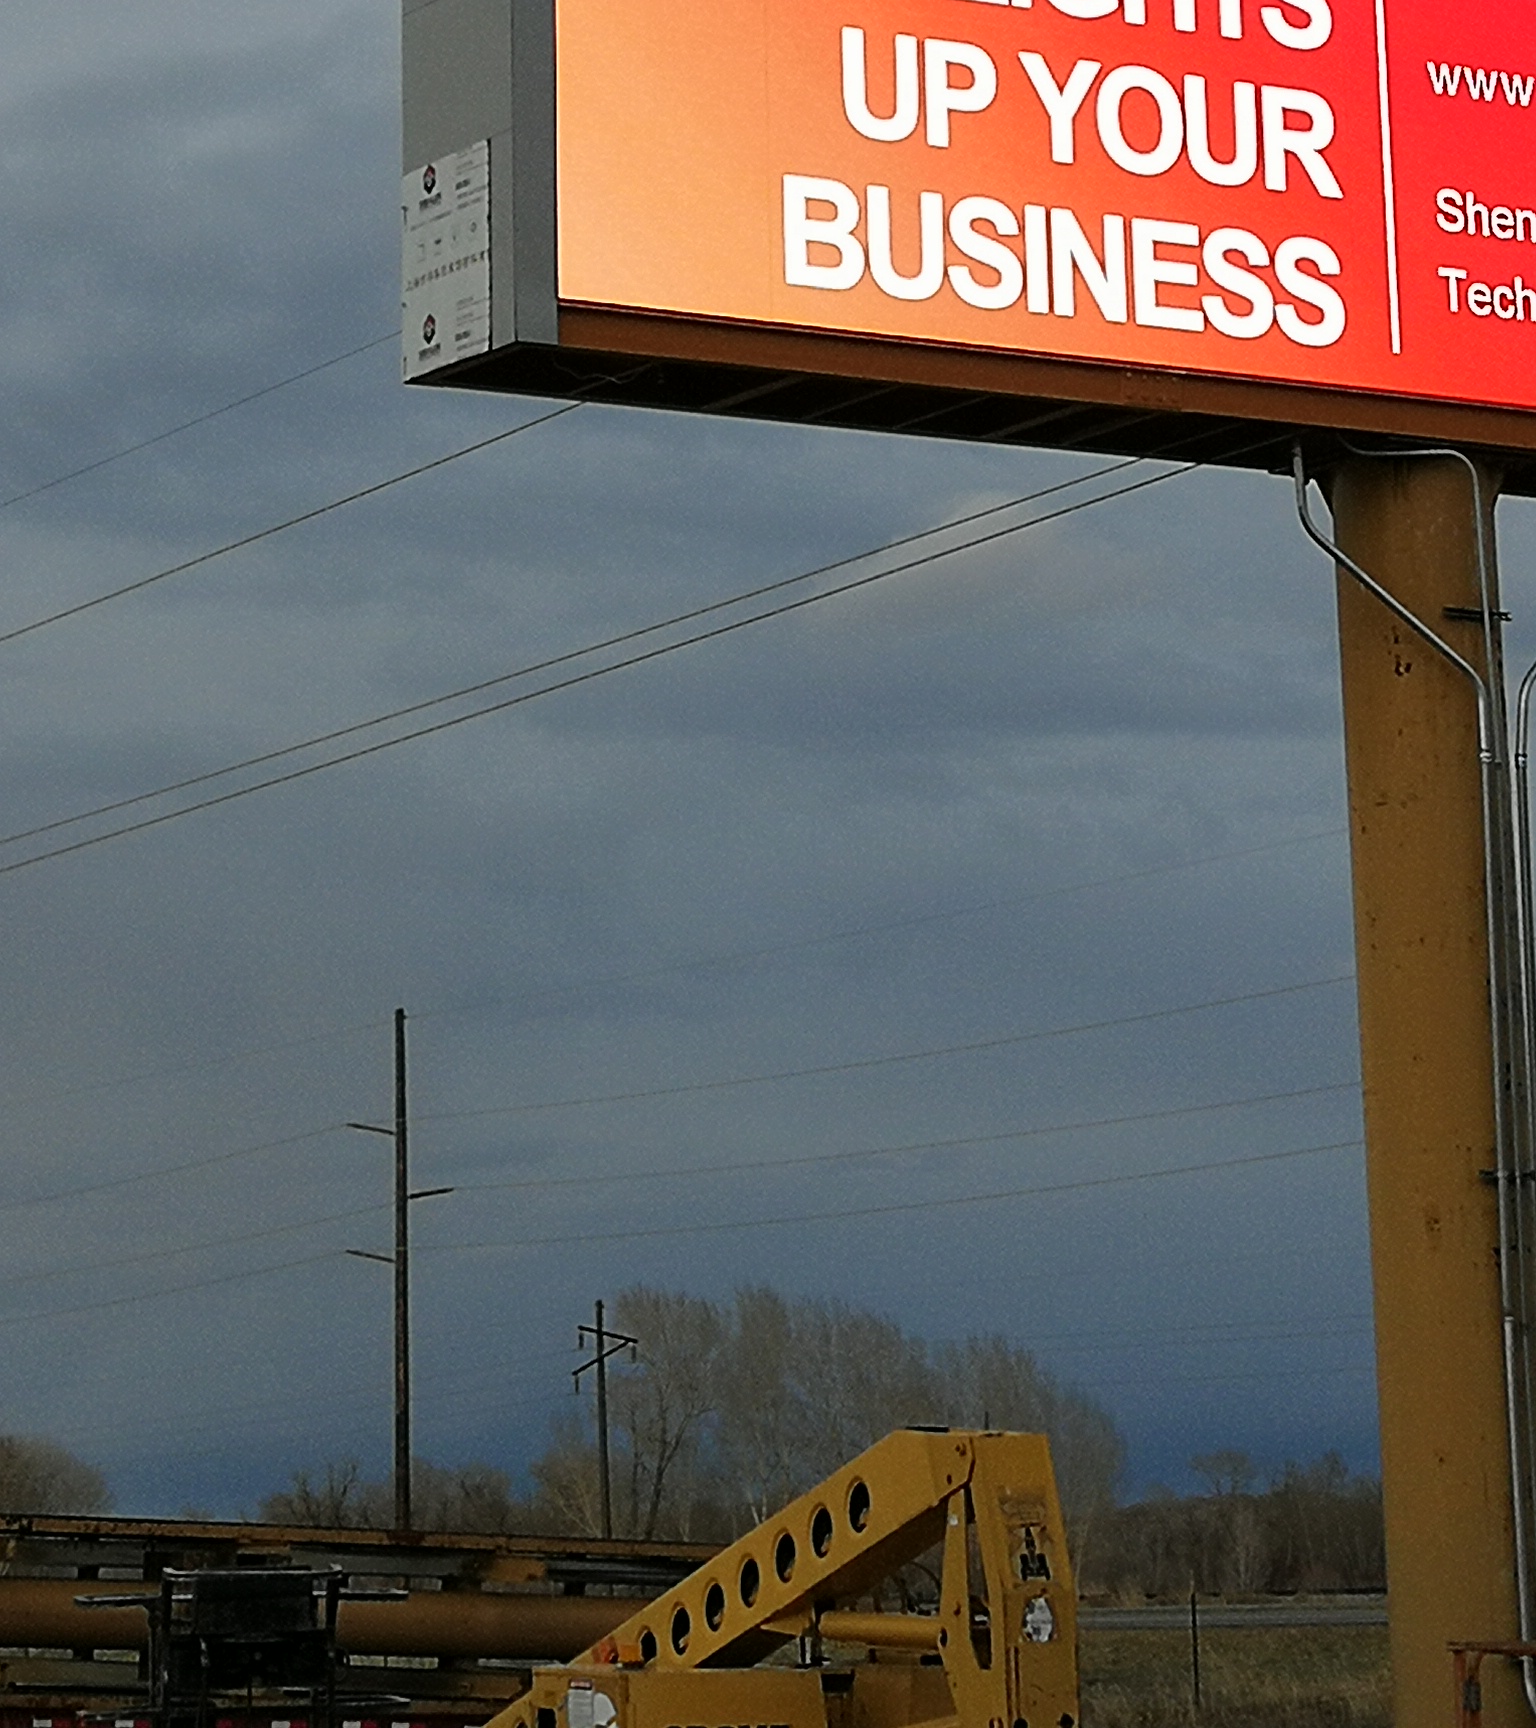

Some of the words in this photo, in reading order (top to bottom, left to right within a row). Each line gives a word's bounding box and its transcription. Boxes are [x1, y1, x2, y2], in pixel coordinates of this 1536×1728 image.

[840, 25, 998, 149] UP
[1018, 50, 1344, 200] YOUR
[782, 173, 1346, 348] BUSINESS
